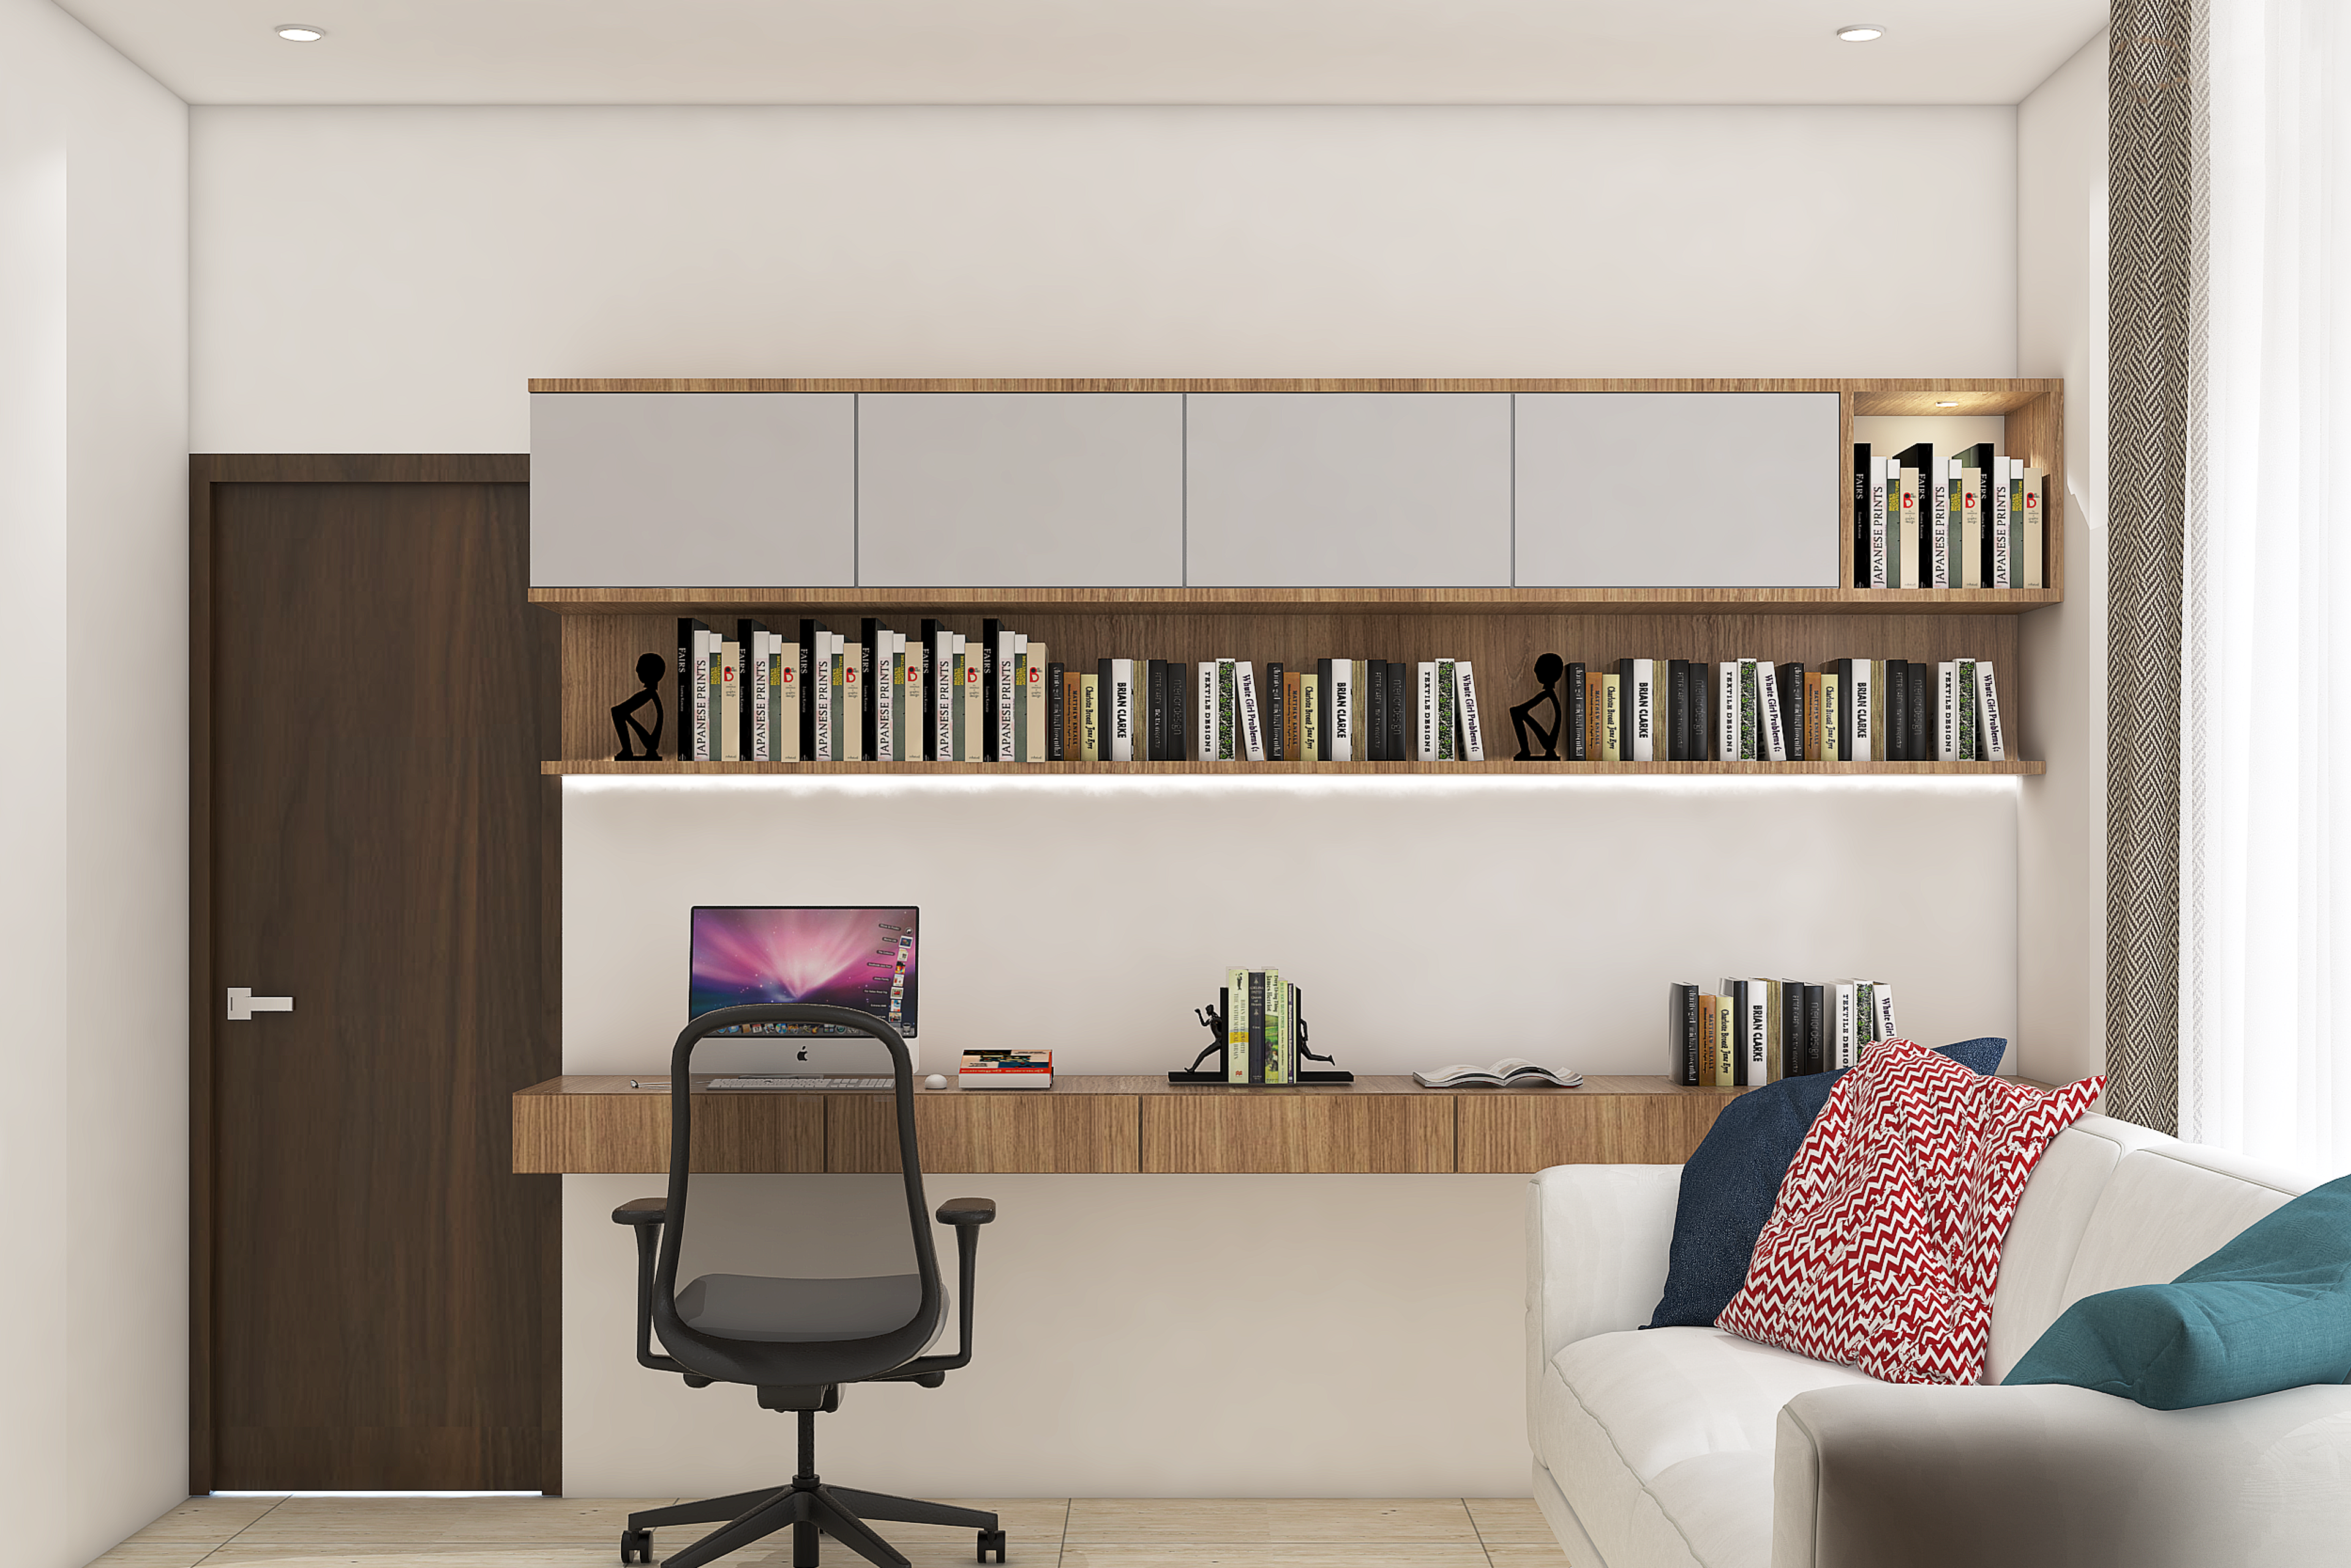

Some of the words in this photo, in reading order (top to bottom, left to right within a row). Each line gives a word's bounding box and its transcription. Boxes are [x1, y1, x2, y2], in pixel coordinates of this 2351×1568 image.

[1873, 487, 1883, 526] PRINTS
[1935, 487, 1944, 526] PRINTS
[1997, 487, 2006, 526] PRINTS
[1873, 530, 1884, 584] JAPANESE
[1935, 530, 1946, 584] JAPANESE
[1997, 530, 2008, 584] JAPANESE
[697, 660, 706, 699] PRINTS
[756, 661, 765, 700] PRINTS
[819, 661, 828, 700] PRINTS
[880, 660, 890, 699] PRINTS
[939, 661, 949, 700] PRINTS
[1001, 661, 1011, 700] PRINTS
[1117, 682, 1127, 707] BRIAN
[1337, 682, 1346, 707] BRIAN
[1639, 682, 1648, 707] BRIAN
[1857, 682, 1866, 707] BRIAN
[1246, 699, 1256, 713] Girl
[1466, 699, 1476, 713] Girl
[1769, 699, 1779, 713] Girl
[1987, 699, 1997, 713] Girl
[697, 702, 708, 756] JAPANESE
[756, 703, 768, 757] JAPANESE
[819, 703, 830, 757] JAPANESE
[880, 702, 891, 756] JAPANESE
[940, 703, 951, 757] JAPANESE
[1001, 703, 1013, 757] JAPANESE
[1117, 709, 1127, 738] CLARKE
[1248, 713, 1258, 746] Problems
[1337, 709, 1346, 738] CLARKE
[1468, 713, 1479, 746] Problems
[1639, 709, 1648, 738] CLARKE
[1771, 713, 1782, 746] Problems
[1857, 709, 1866, 738] CLARKE
[1989, 713, 1999, 746] Problems
[1753, 1005, 1763, 1030] BRIAN
[1884, 1022, 1894, 1037] Girl
[1753, 1032, 1763, 1062] CLARKE
